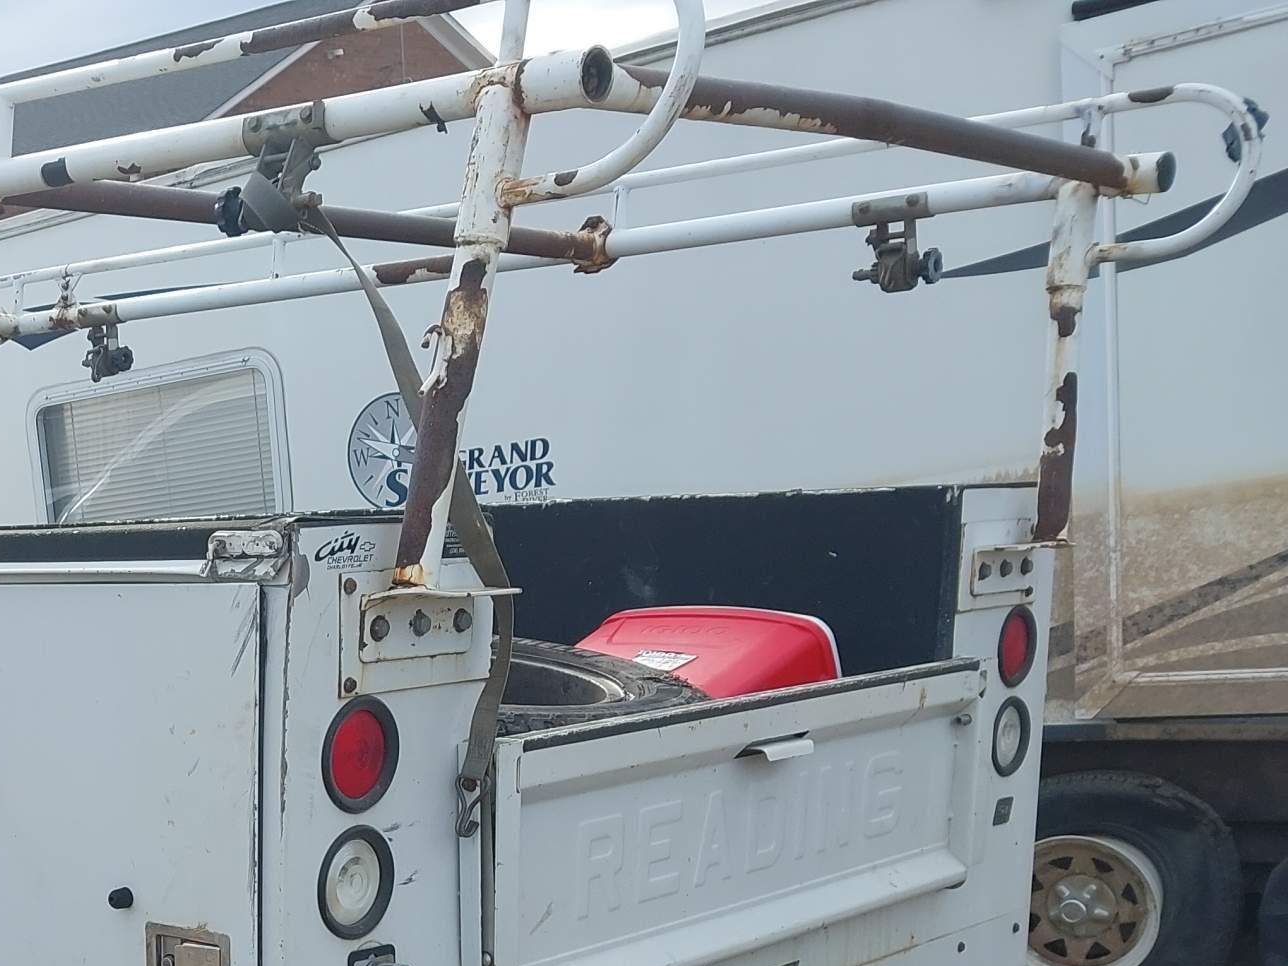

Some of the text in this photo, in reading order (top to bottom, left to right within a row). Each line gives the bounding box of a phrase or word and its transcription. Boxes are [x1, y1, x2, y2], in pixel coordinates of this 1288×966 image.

[384, 399, 400, 419] N
[353, 447, 370, 468] W
[314, 530, 361, 562] City
[327, 553, 374, 565] CHEVROLET
[577, 750, 904, 920] READING
